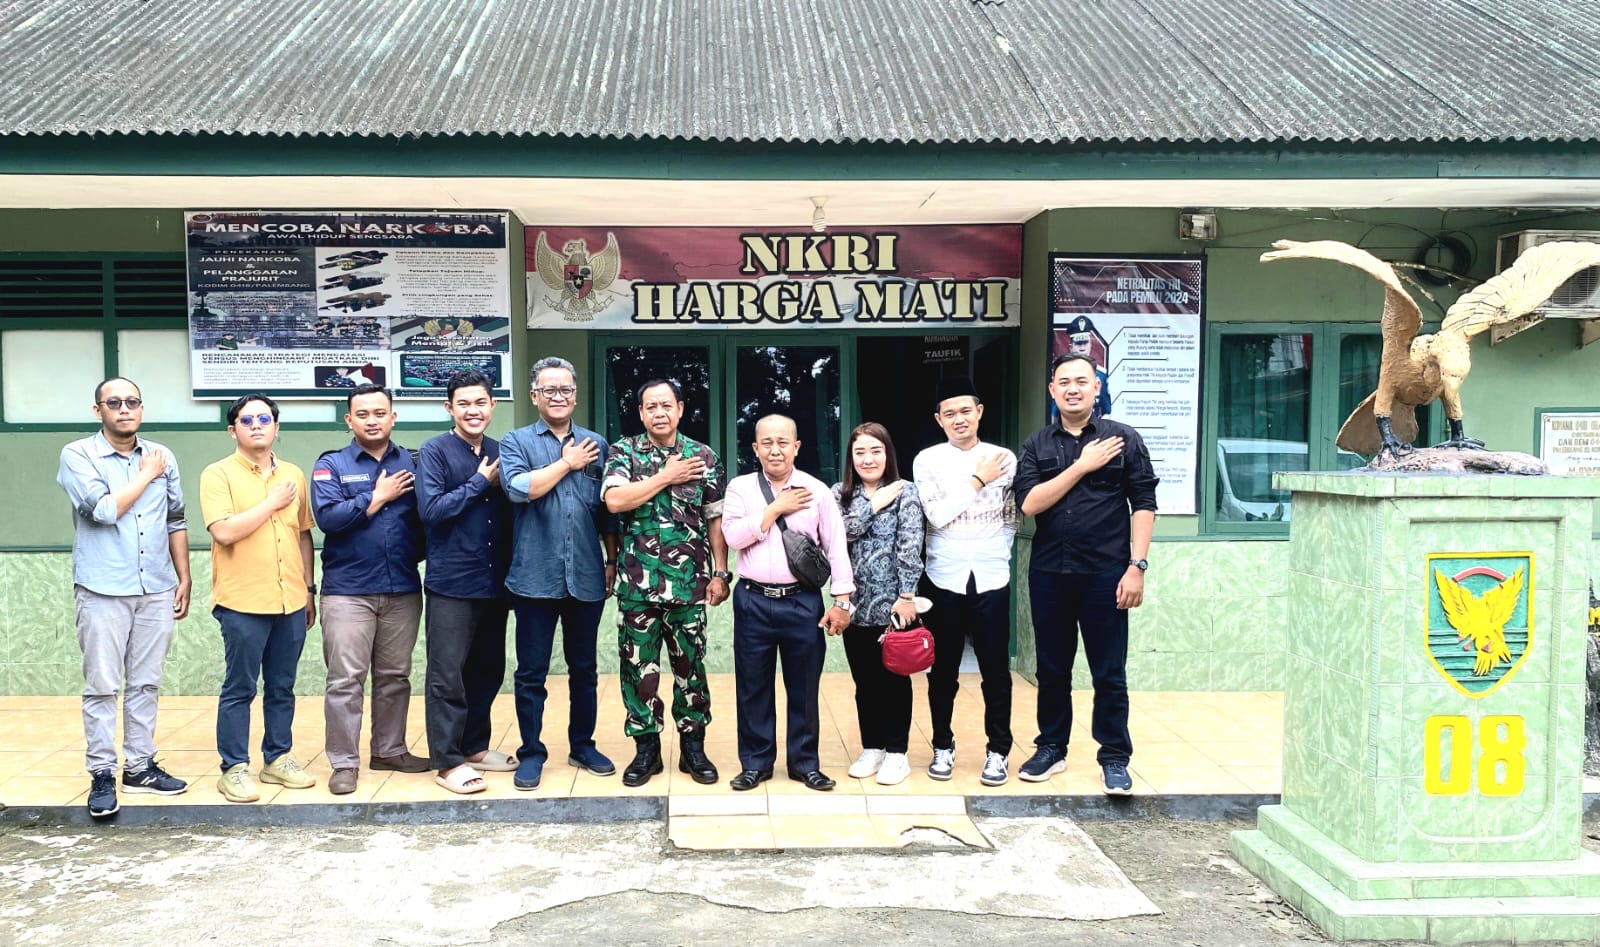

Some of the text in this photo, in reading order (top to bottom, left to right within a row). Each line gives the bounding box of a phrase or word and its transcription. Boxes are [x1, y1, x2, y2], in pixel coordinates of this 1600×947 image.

[205, 223, 333, 233] MENCOBA
[740, 232, 900, 274] NKRI
[1116, 278, 1166, 290] NETRALITAS
[631, 280, 1008, 324] HARGA MATI
[1106, 291, 1189, 304] PADA PEMILU 2024
[924, 349, 961, 358] TAUFIK
[1424, 714, 1526, 796] 08
